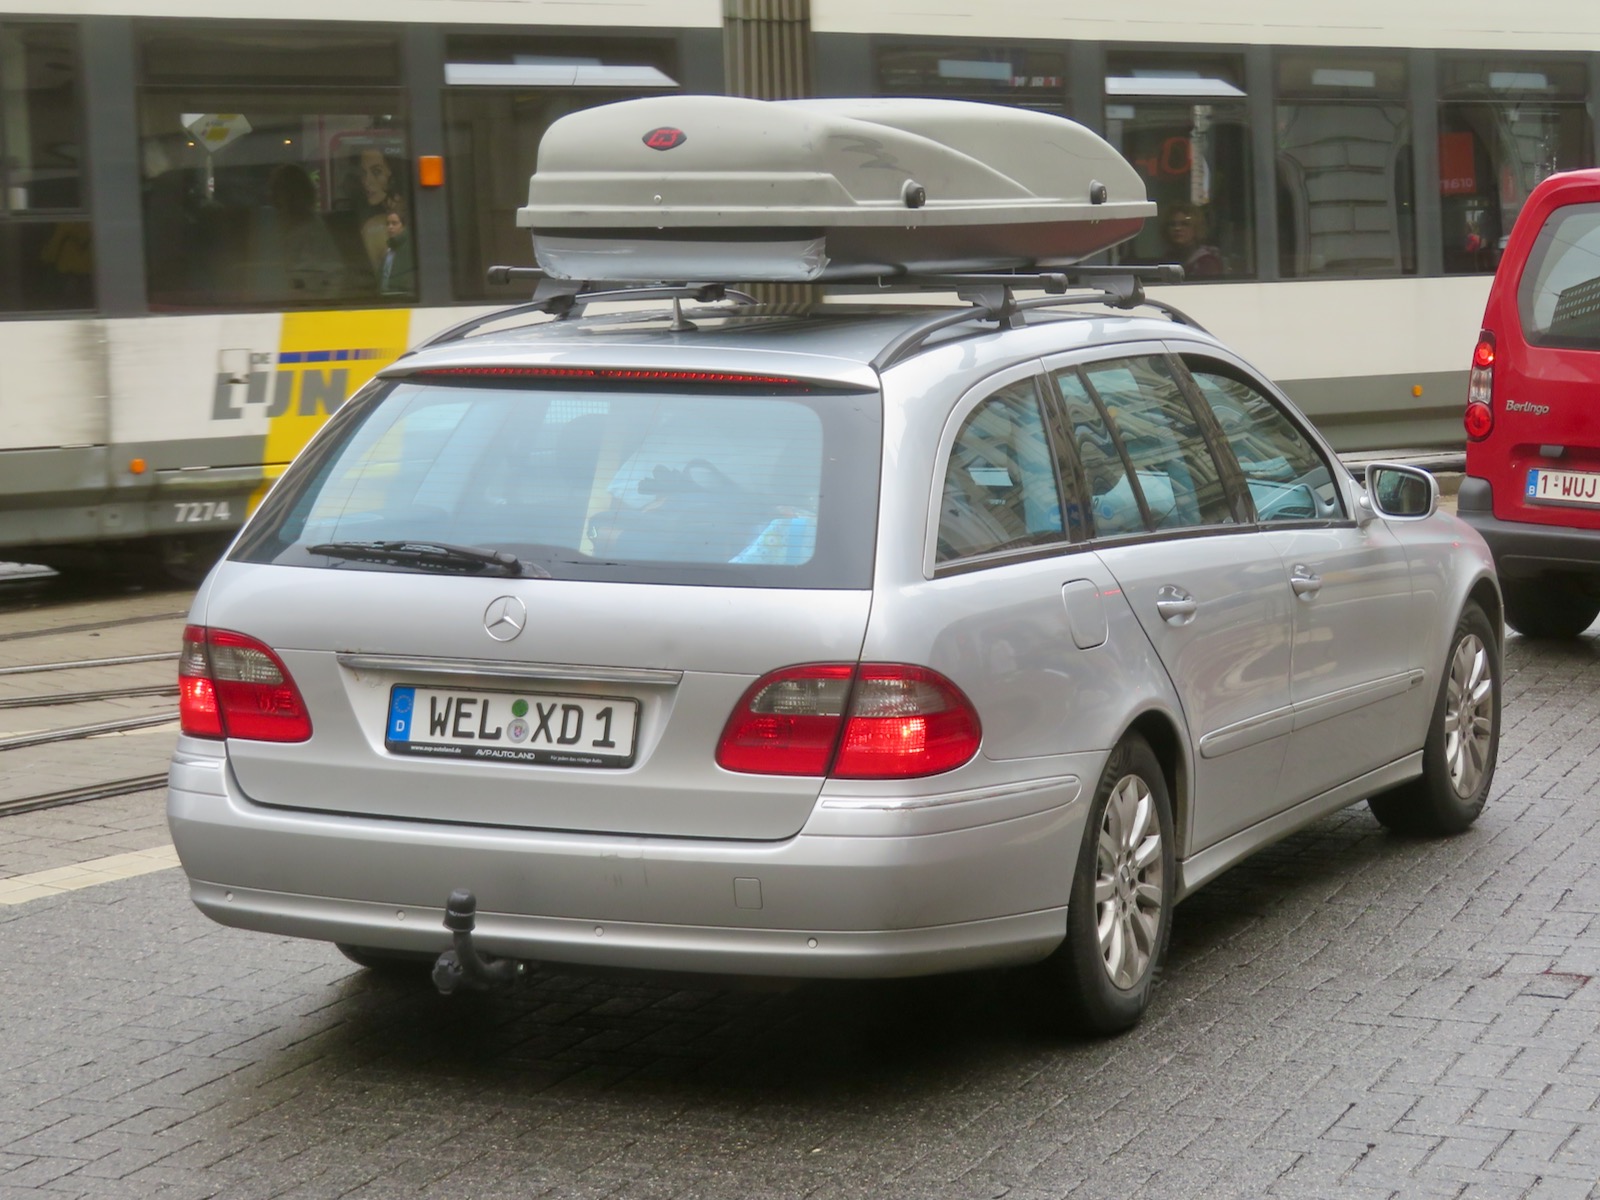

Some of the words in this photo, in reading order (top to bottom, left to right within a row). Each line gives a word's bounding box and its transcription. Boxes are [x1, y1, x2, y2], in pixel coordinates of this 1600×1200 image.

[1505, 400, 1549, 415] Berlingo
[174, 502, 230, 522] 7274
[395, 720, 405, 732] D
[429, 696, 502, 740] WEL
